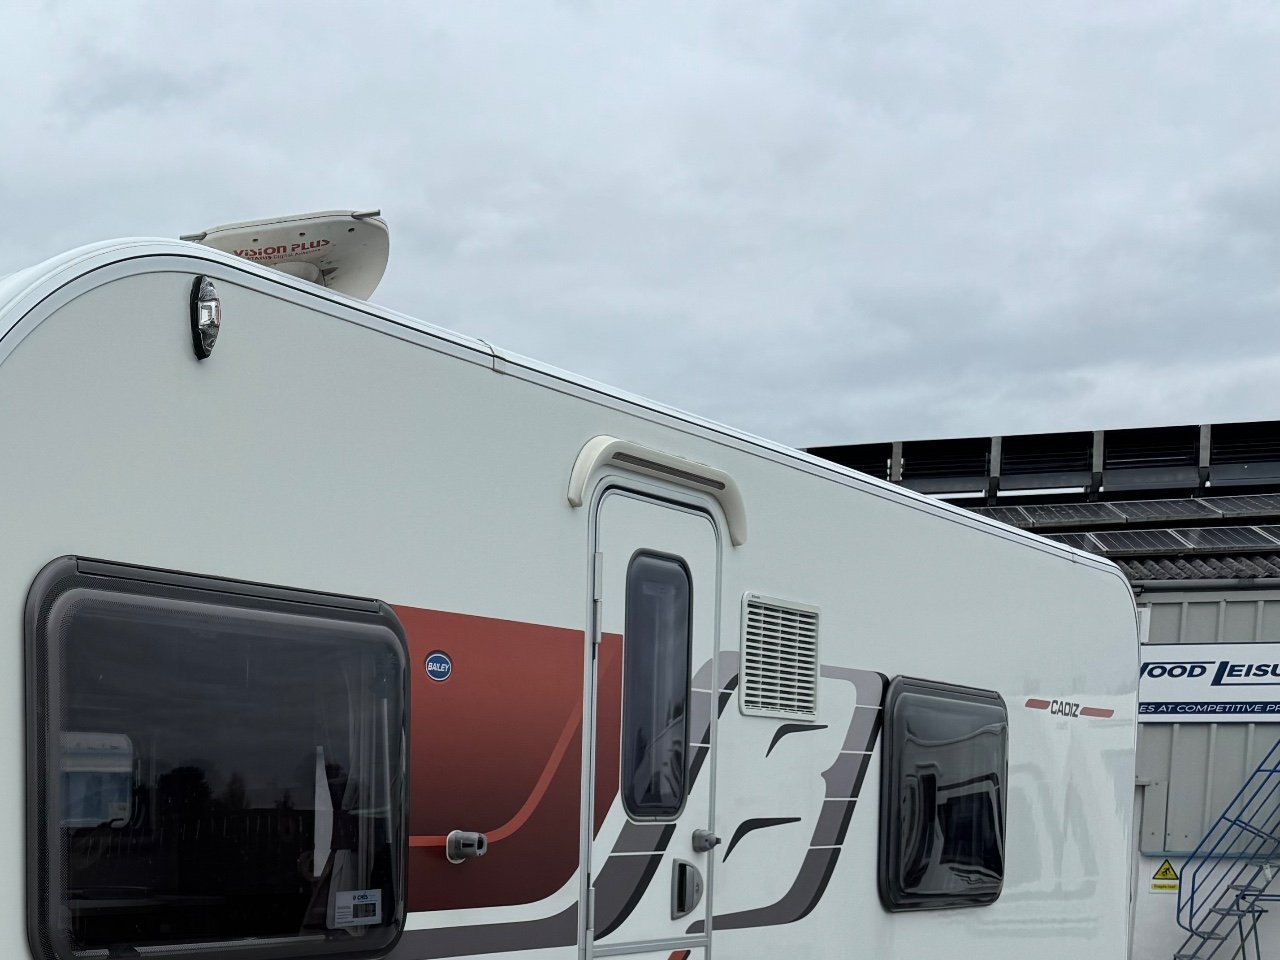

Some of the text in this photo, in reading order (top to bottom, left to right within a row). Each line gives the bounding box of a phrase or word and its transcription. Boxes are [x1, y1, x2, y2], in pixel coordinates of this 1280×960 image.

[292, 239, 330, 252] PLUS
[427, 663, 450, 672] BAILEY
[1139, 661, 1216, 679] OOD
[1050, 700, 1080, 718] CADIZ
[1158, 704, 1176, 712] AT
[1176, 704, 1263, 713] COMPETITIVE
